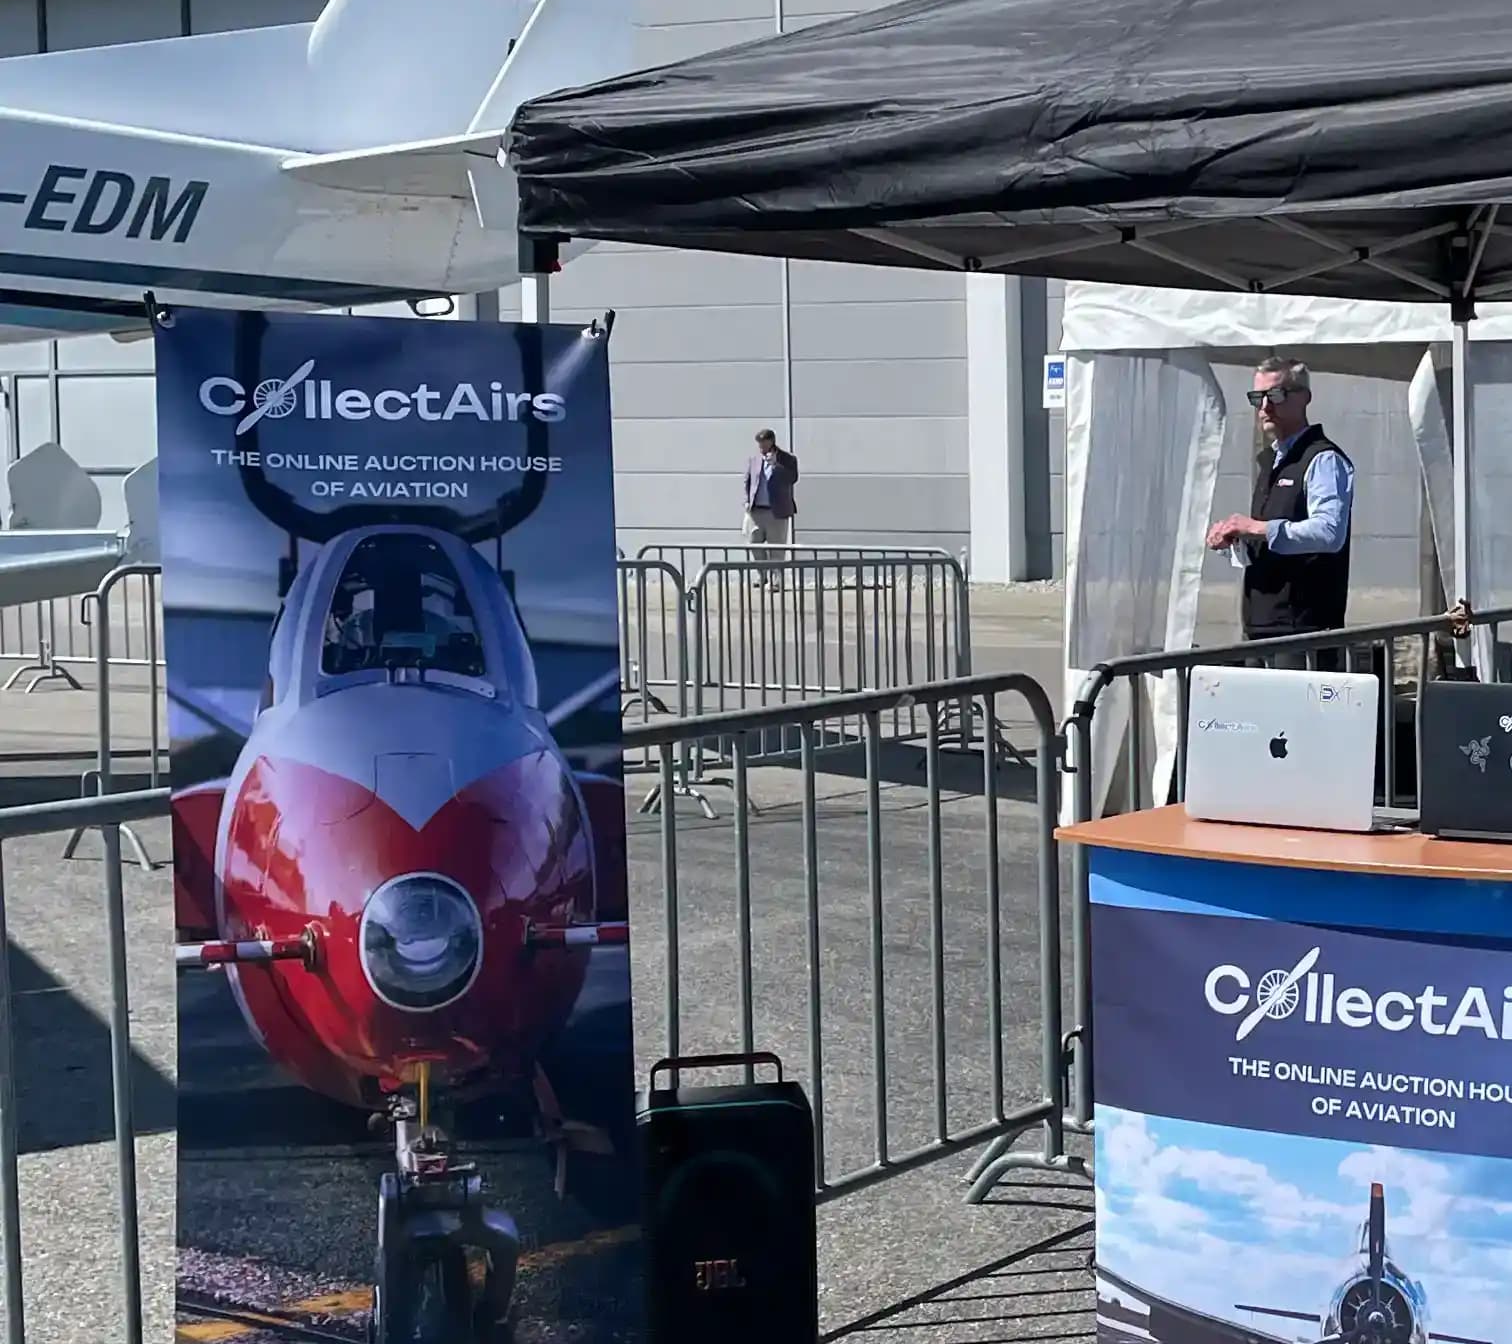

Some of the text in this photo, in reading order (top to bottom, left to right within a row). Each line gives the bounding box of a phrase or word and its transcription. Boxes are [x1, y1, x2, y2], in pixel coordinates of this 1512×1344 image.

[199, 359, 567, 435] CollectAirs
[210, 450, 563, 472] THE ONLINE AUCTION HOUSE
[311, 480, 468, 498] OF AVIATION
[1228, 1056, 1270, 1078] THE
[1274, 1062, 1356, 1087] ONLINE
[1360, 1071, 1464, 1098] AUCTION
[1311, 1096, 1456, 1129] OF AVIATION
